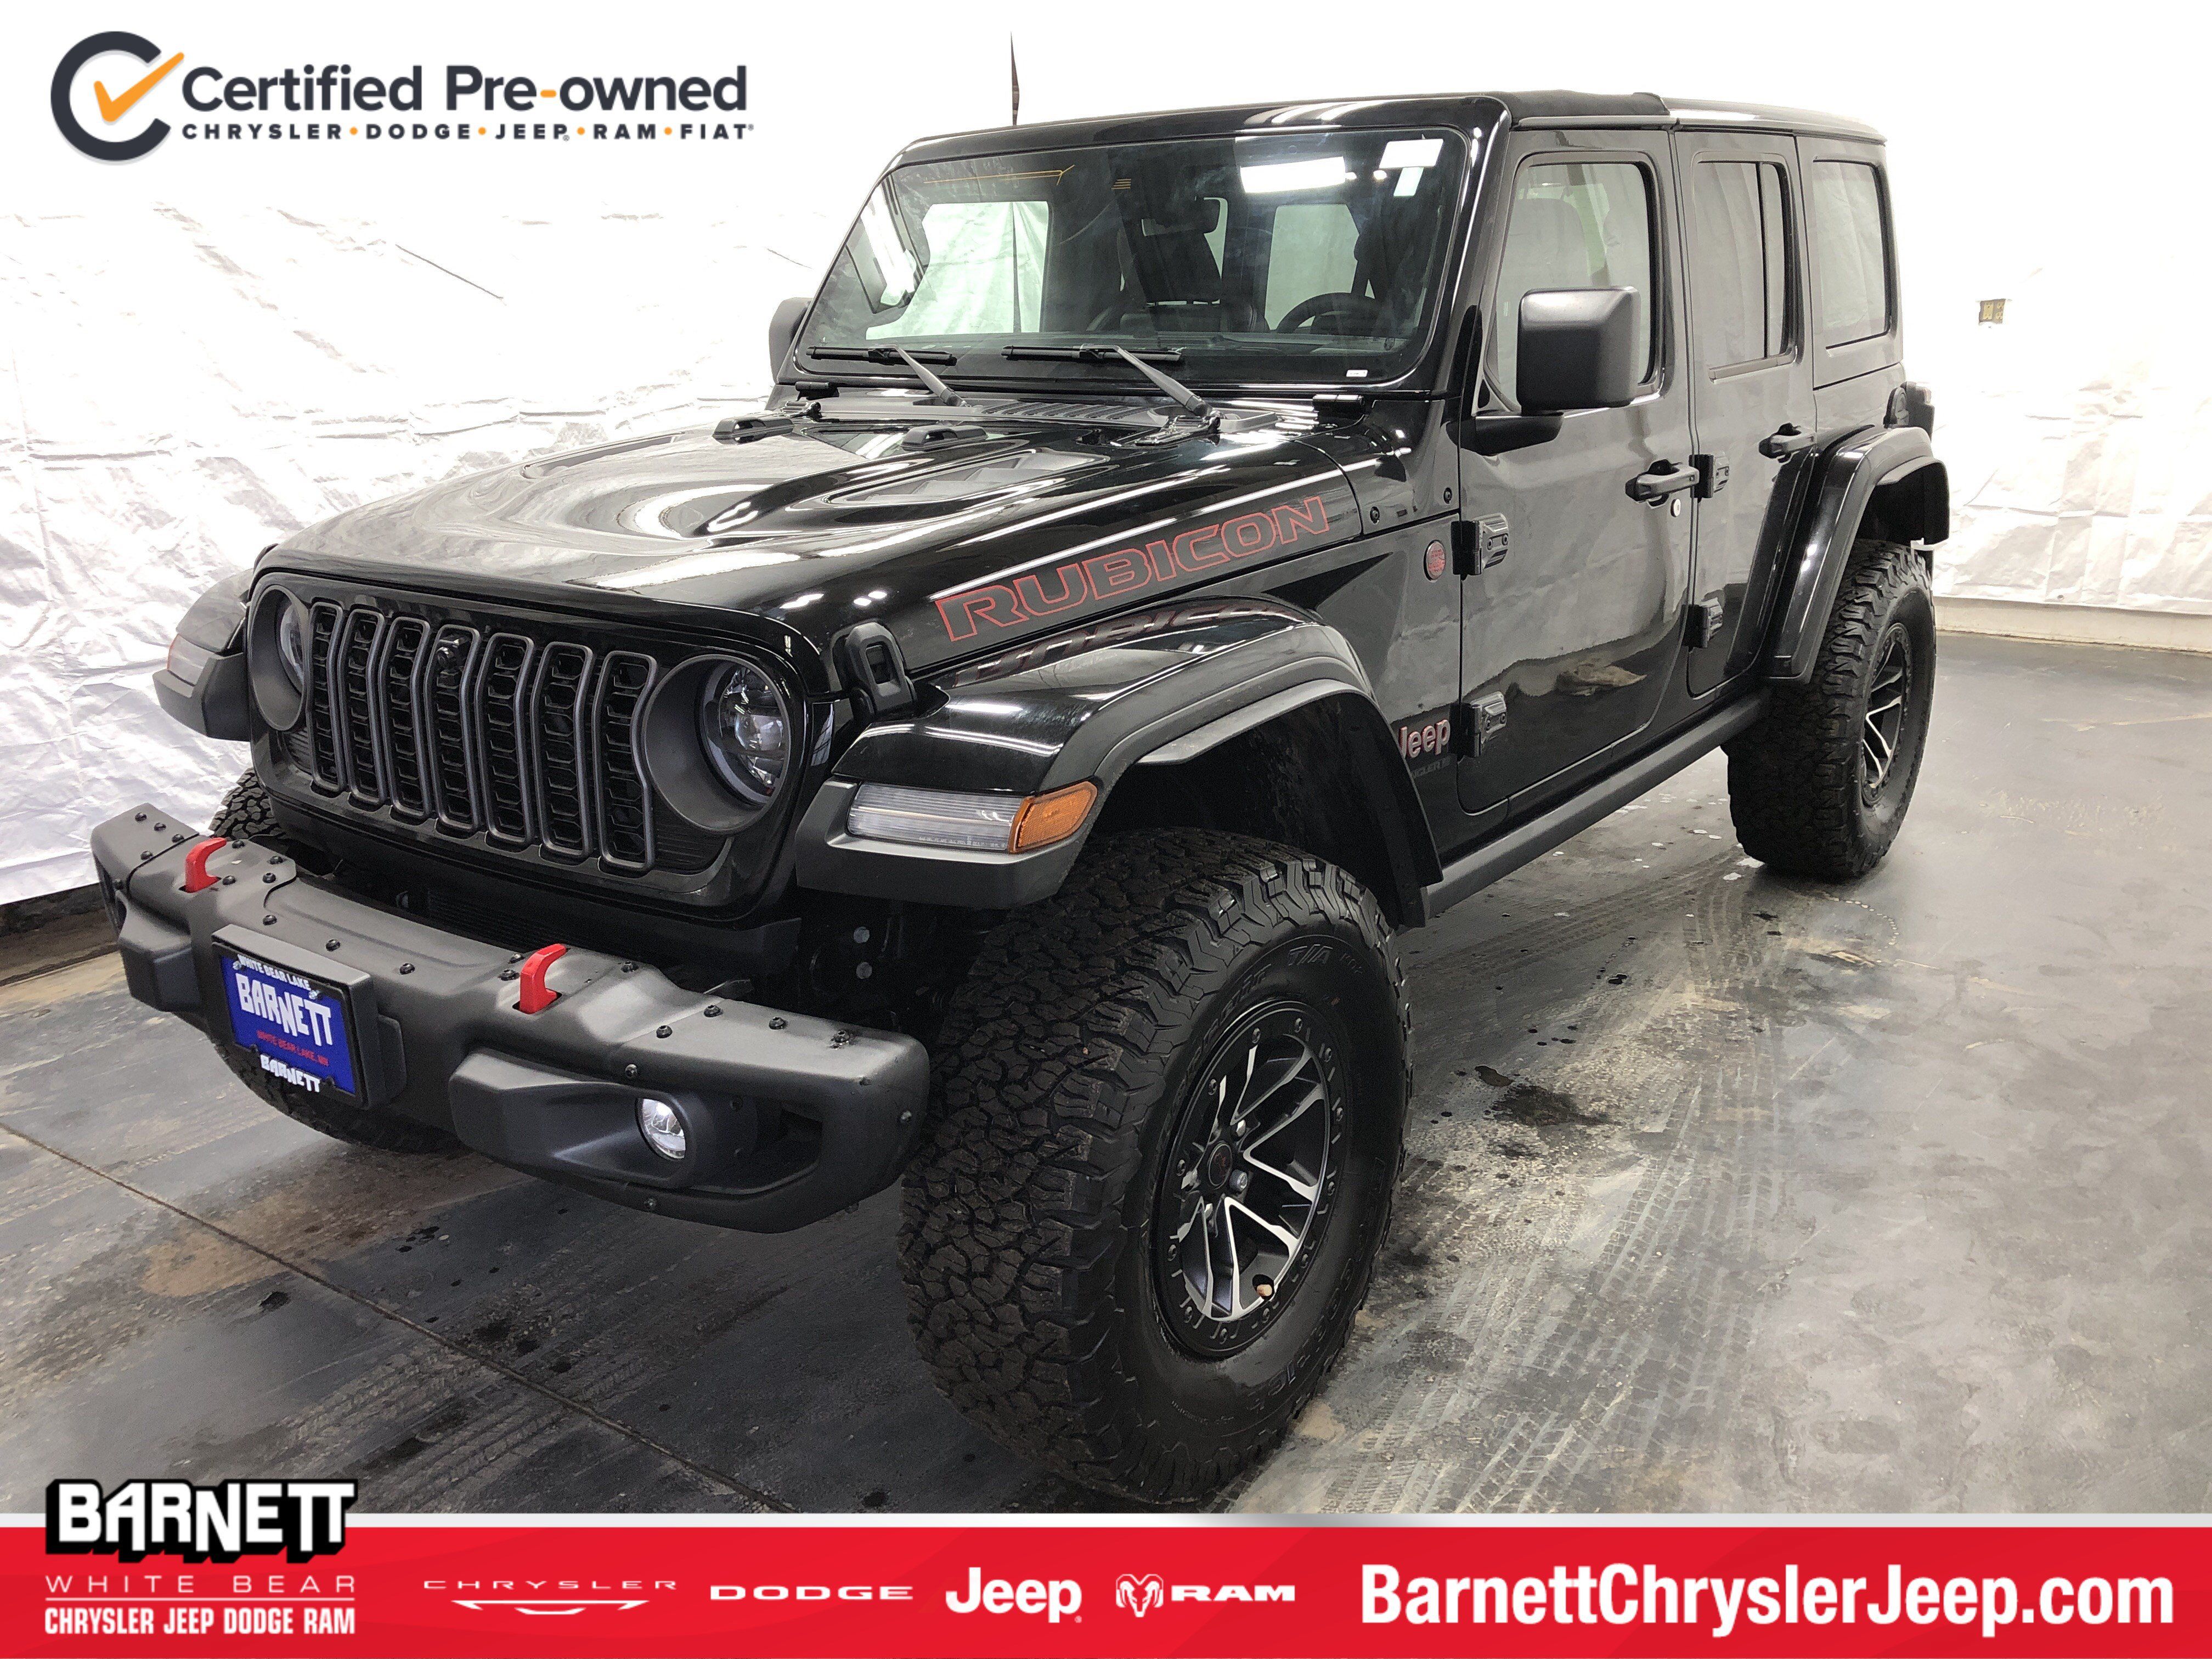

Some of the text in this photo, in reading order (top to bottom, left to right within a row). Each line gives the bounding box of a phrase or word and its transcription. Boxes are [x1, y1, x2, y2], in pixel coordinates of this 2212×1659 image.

[934, 495, 1331, 642] RUBICON
[1398, 719, 1451, 758] Jeep
[237, 954, 312, 991] WHITE BEAR LAKE
[235, 972, 333, 1047] BARNETT
[260, 1054, 321, 1093] BARNETT
